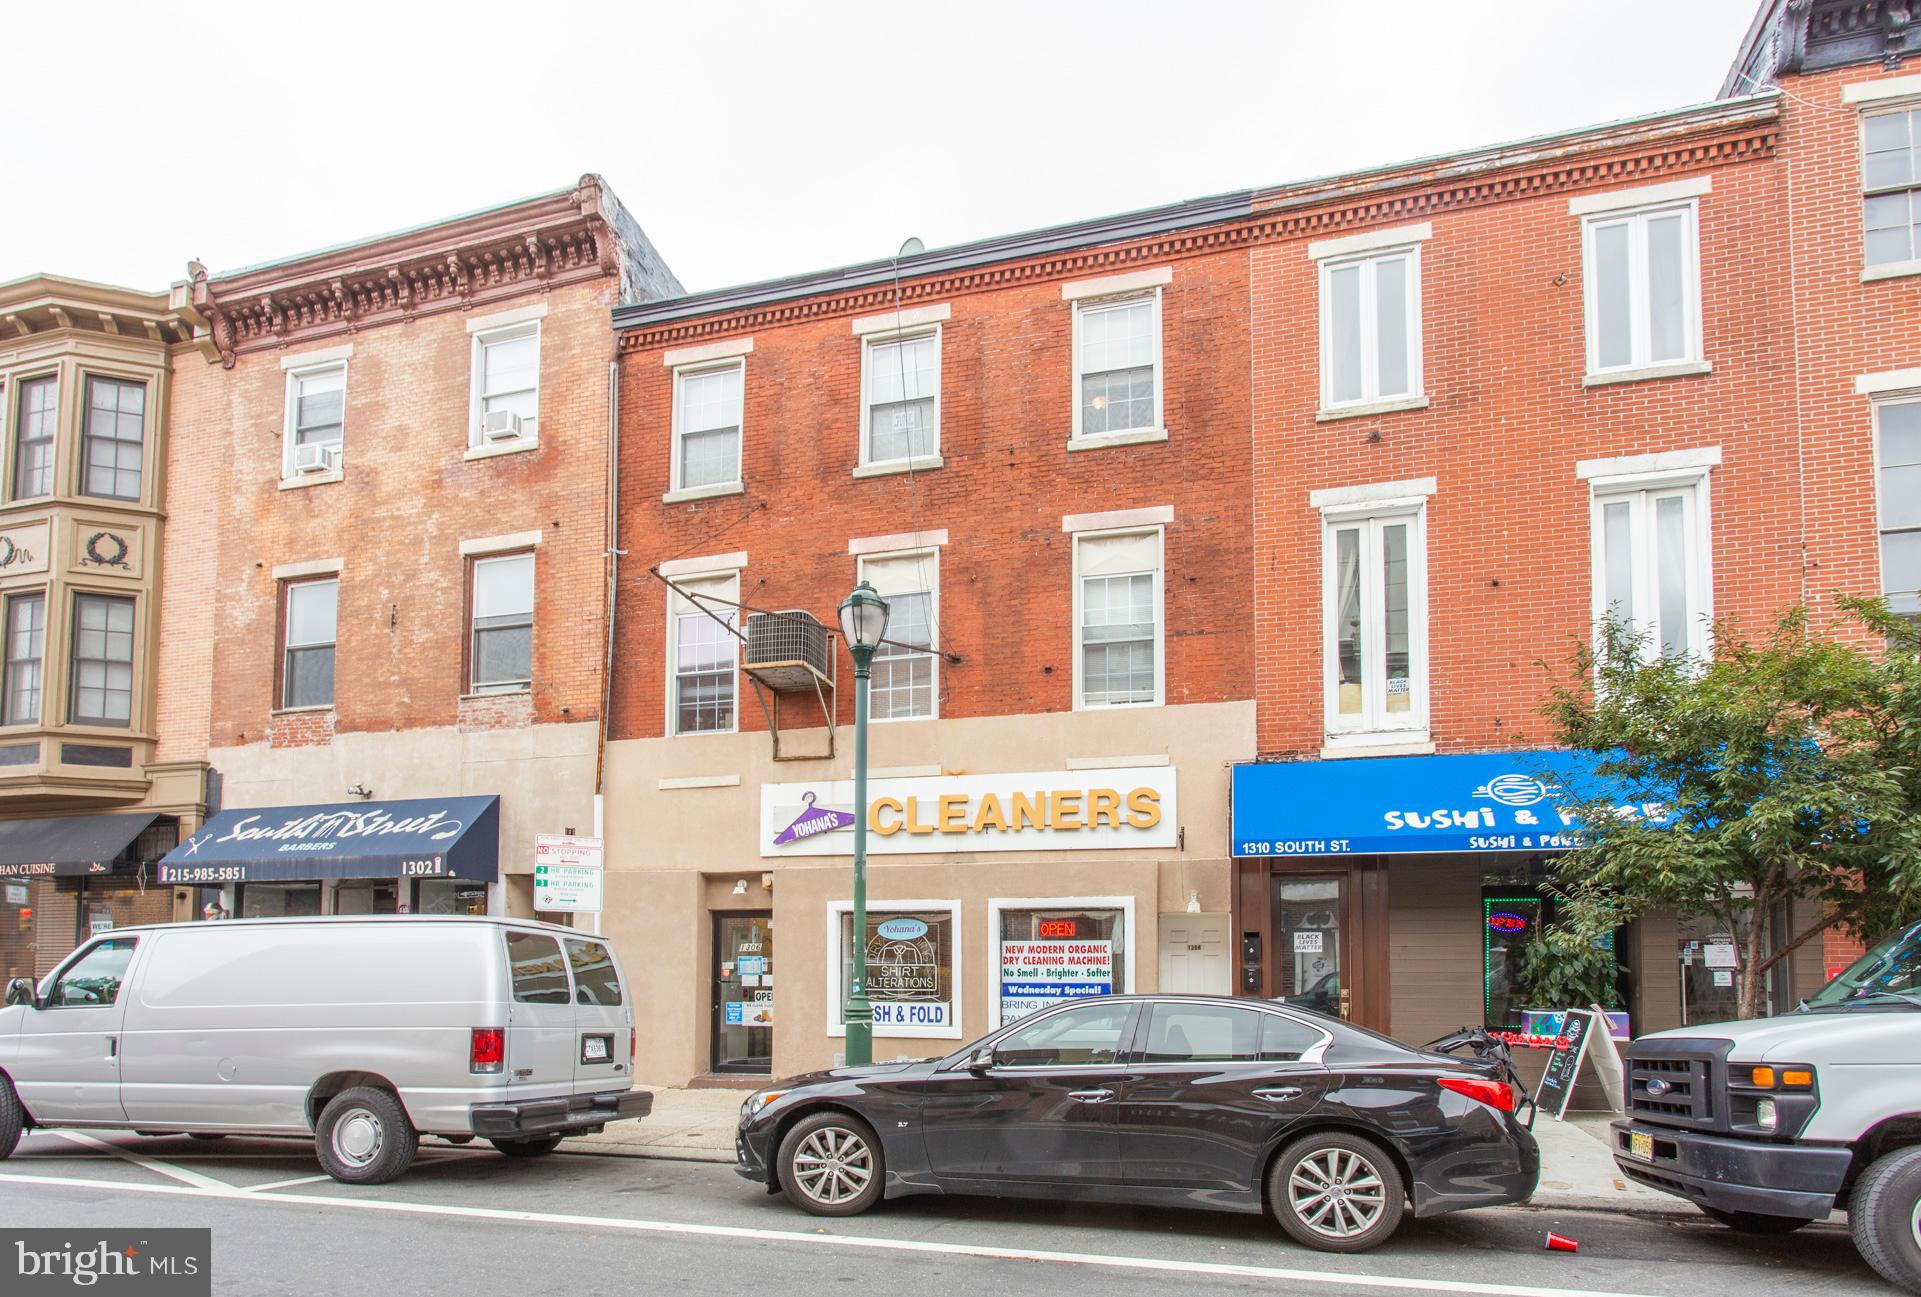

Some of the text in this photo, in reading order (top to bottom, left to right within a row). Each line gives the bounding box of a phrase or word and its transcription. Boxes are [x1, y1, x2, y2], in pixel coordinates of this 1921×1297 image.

[868, 787, 1162, 836] CLEANERS
[1514, 809, 1539, 825] &
[216, 809, 462, 842] South Street
[792, 812, 839, 838] YOHANA'S
[277, 842, 337, 851] BARBERS
[1242, 840, 1350, 854] 1310 SOUTH ST.
[1522, 836, 1533, 847] &
[552, 848, 591, 856] STOPPING
[20, 863, 56, 874] CUISINE
[169, 866, 246, 881] 215-985-5851
[402, 861, 432, 875] 1302
[883, 924, 922, 934] Yohana's
[1040, 922, 1074, 936] OPEN
[1005, 945, 1108, 954] NEW MODERN ORGANIC
[1003, 956, 1110, 965] DRY CLEANING MACHINE!
[881, 966, 920, 977] SHIRT
[1004, 968, 1110, 980] No Smell Brighter Softer
[866, 977, 934, 988] ALTERATIONS
[756, 992, 773, 1001] OPE
[1008, 986, 1102, 996] Wednesday Special!
[1002, 1000, 1038, 1010] BRING
[872, 1005, 943, 1023] SH & FOLD
